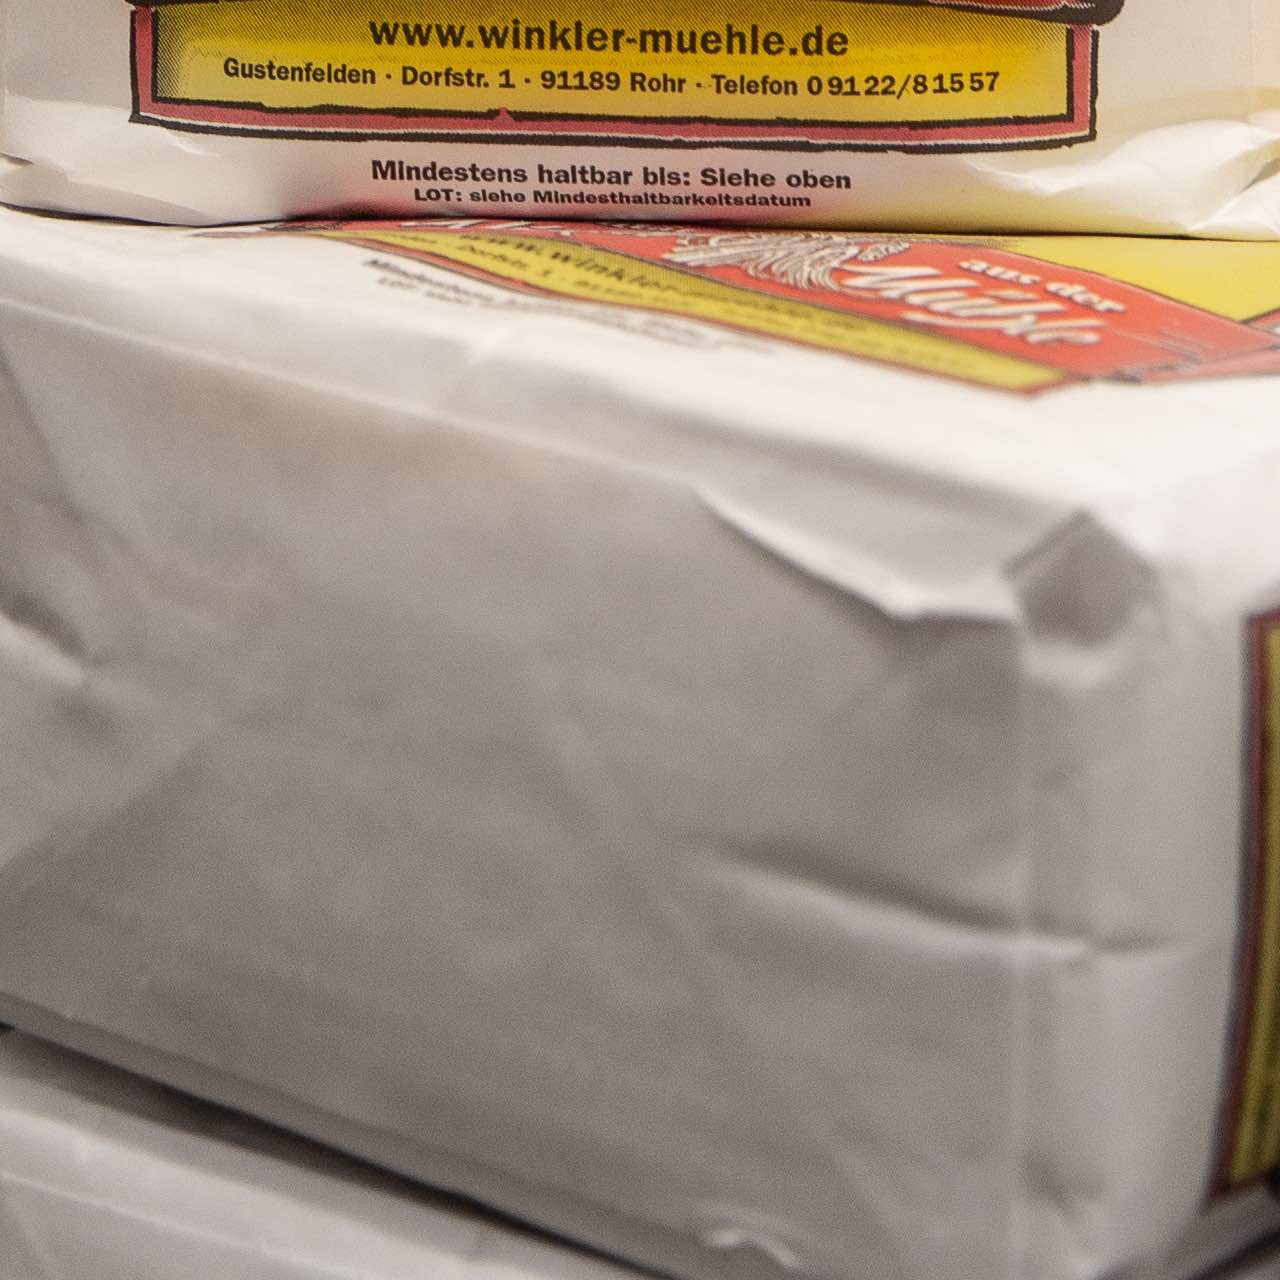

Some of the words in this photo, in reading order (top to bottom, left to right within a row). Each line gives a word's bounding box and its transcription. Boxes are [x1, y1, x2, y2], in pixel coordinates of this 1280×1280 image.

[368, 18, 849, 57] www.winkler-muehle.de
[223, 56, 377, 85] Gustenfelden
[401, 64, 490, 88] Dorfstr.
[498, 69, 516, 89] 1
[539, 69, 621, 92] 91189
[629, 71, 687, 94] Rohr
[711, 73, 798, 97] Telefon
[371, 159, 528, 184] Mindestens
[537, 163, 632, 187] haltbar
[641, 165, 692, 187] bis:
[699, 167, 776, 189] Siehe
[785, 169, 851, 190] oben
[413, 187, 463, 203] LOT:
[469, 188, 526, 204] siehe
[532, 189, 811, 208] Mindesthaltbarkeitsdatum
[957, 257, 1042, 287] aus
[1044, 280, 1128, 314] der
